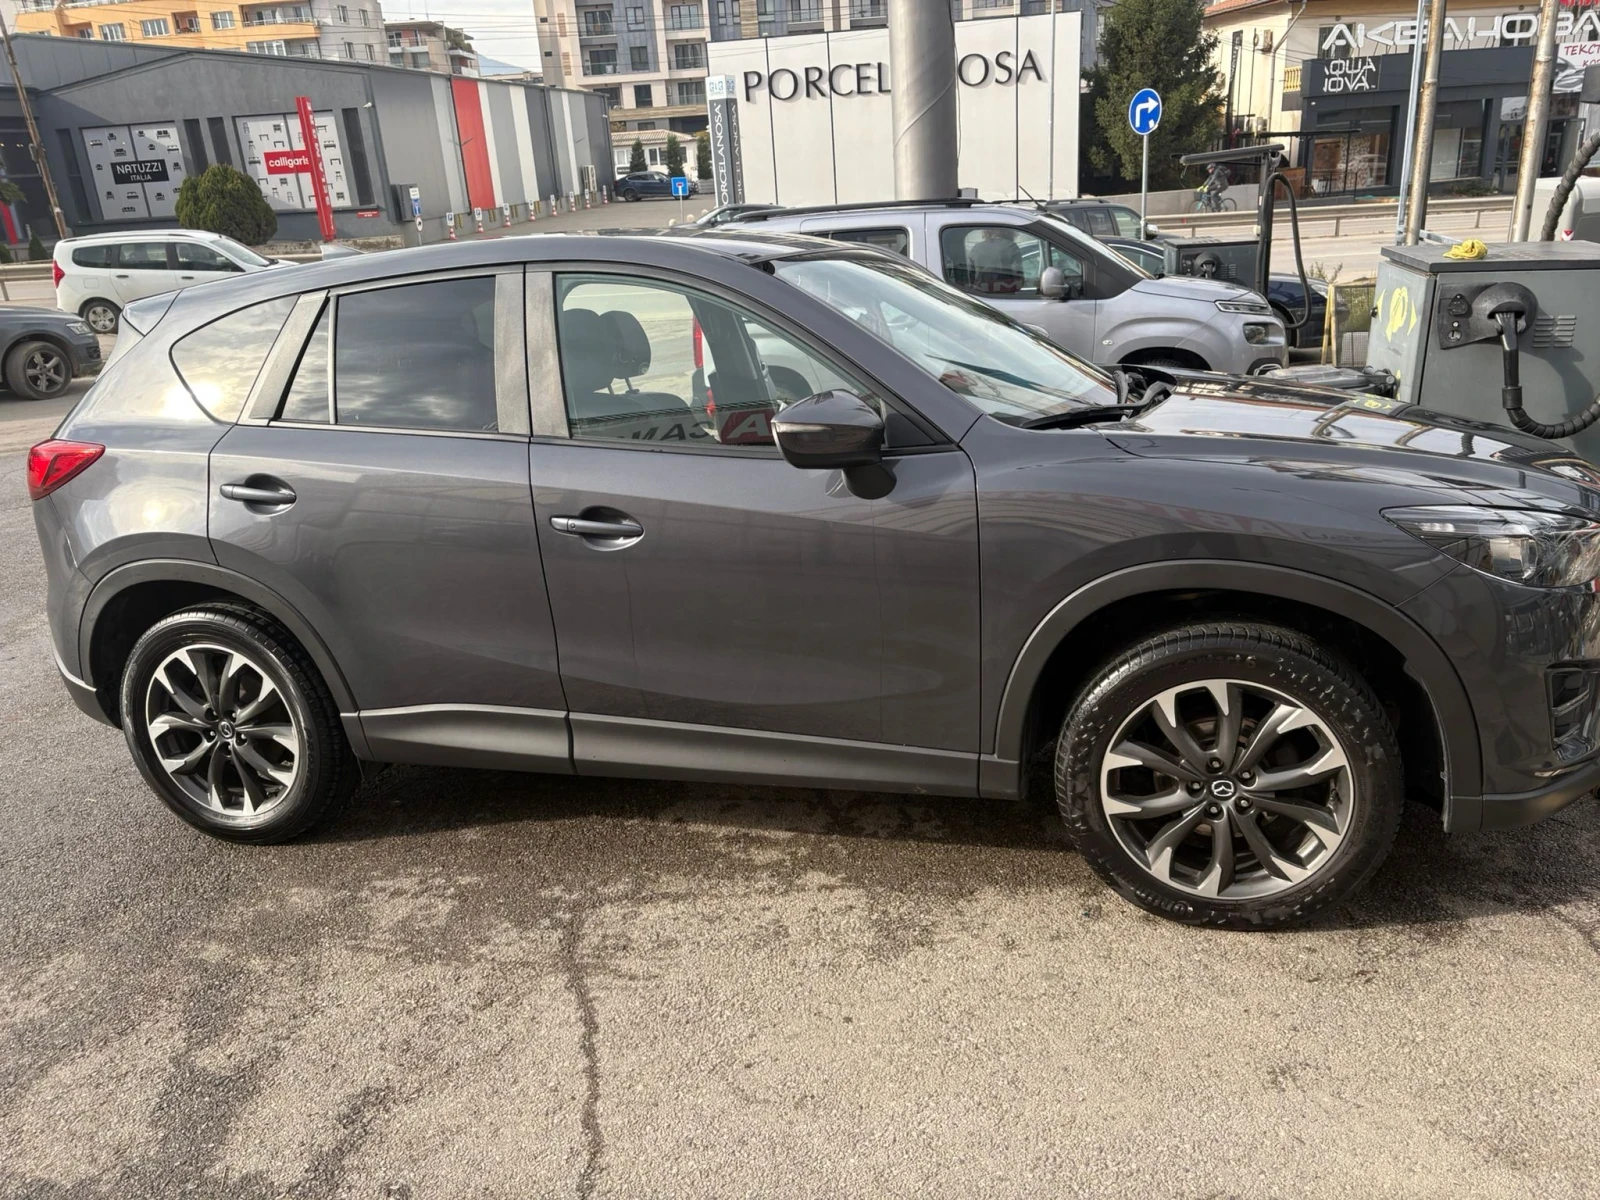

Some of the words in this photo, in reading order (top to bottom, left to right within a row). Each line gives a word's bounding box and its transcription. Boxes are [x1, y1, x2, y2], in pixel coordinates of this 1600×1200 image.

[743, 49, 1043, 103] PORCELOSA
[116, 162, 162, 174] NATUZZI
[268, 156, 310, 168] calligaris
[714, 102, 729, 208] ORCELANOSA
[731, 102, 744, 204] ORCELANOSA
